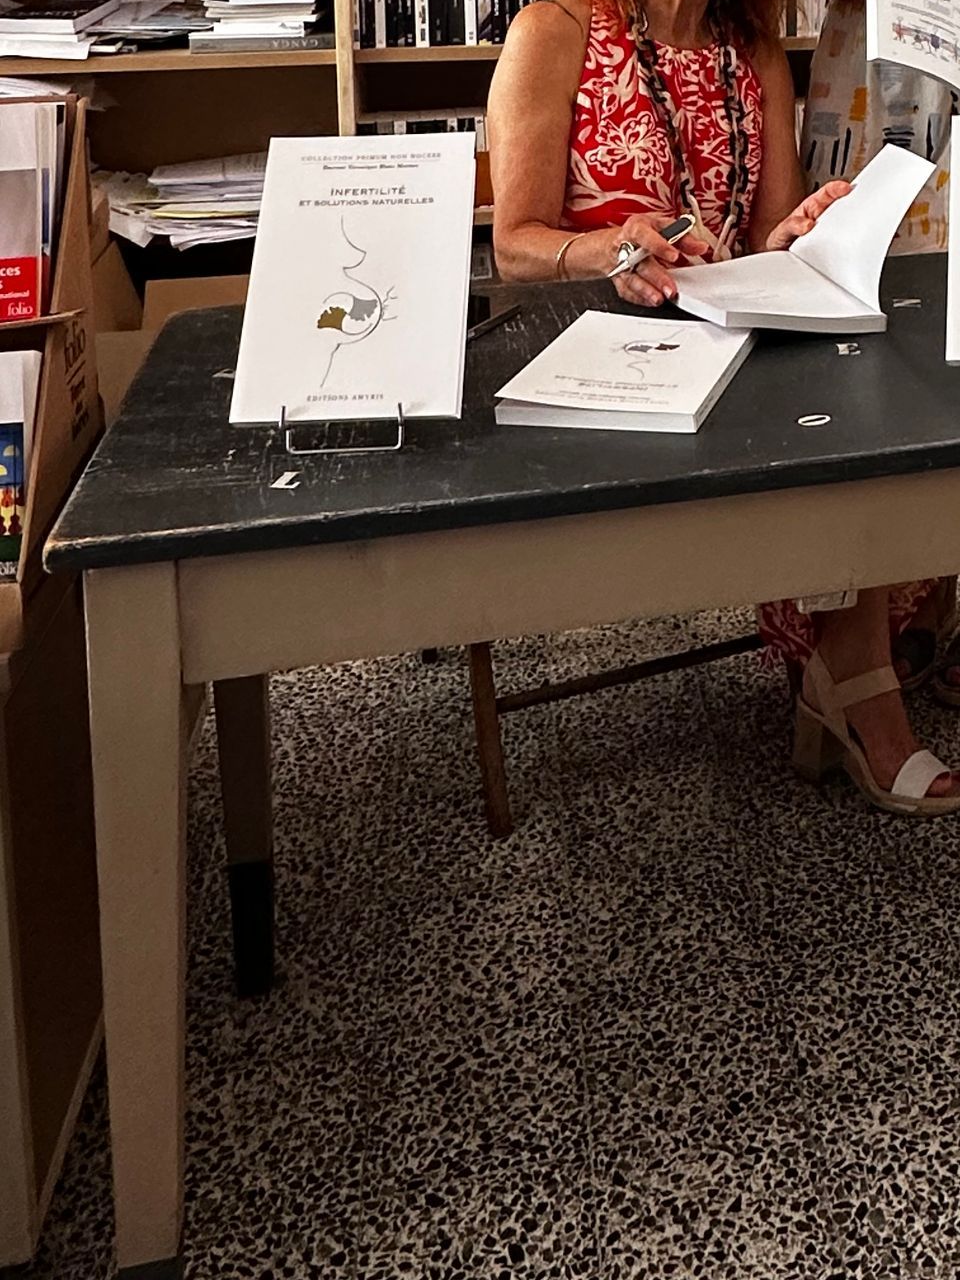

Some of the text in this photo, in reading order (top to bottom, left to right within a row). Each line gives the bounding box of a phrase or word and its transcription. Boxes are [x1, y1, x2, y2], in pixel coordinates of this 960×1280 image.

[271, 38, 318, 49] GANGA
[331, 185, 407, 196] INFERTILITÉ
[314, 199, 369, 207] SOLUTIONS
[372, 197, 434, 206] NATURELLES
[8, 301, 33, 316] folio
